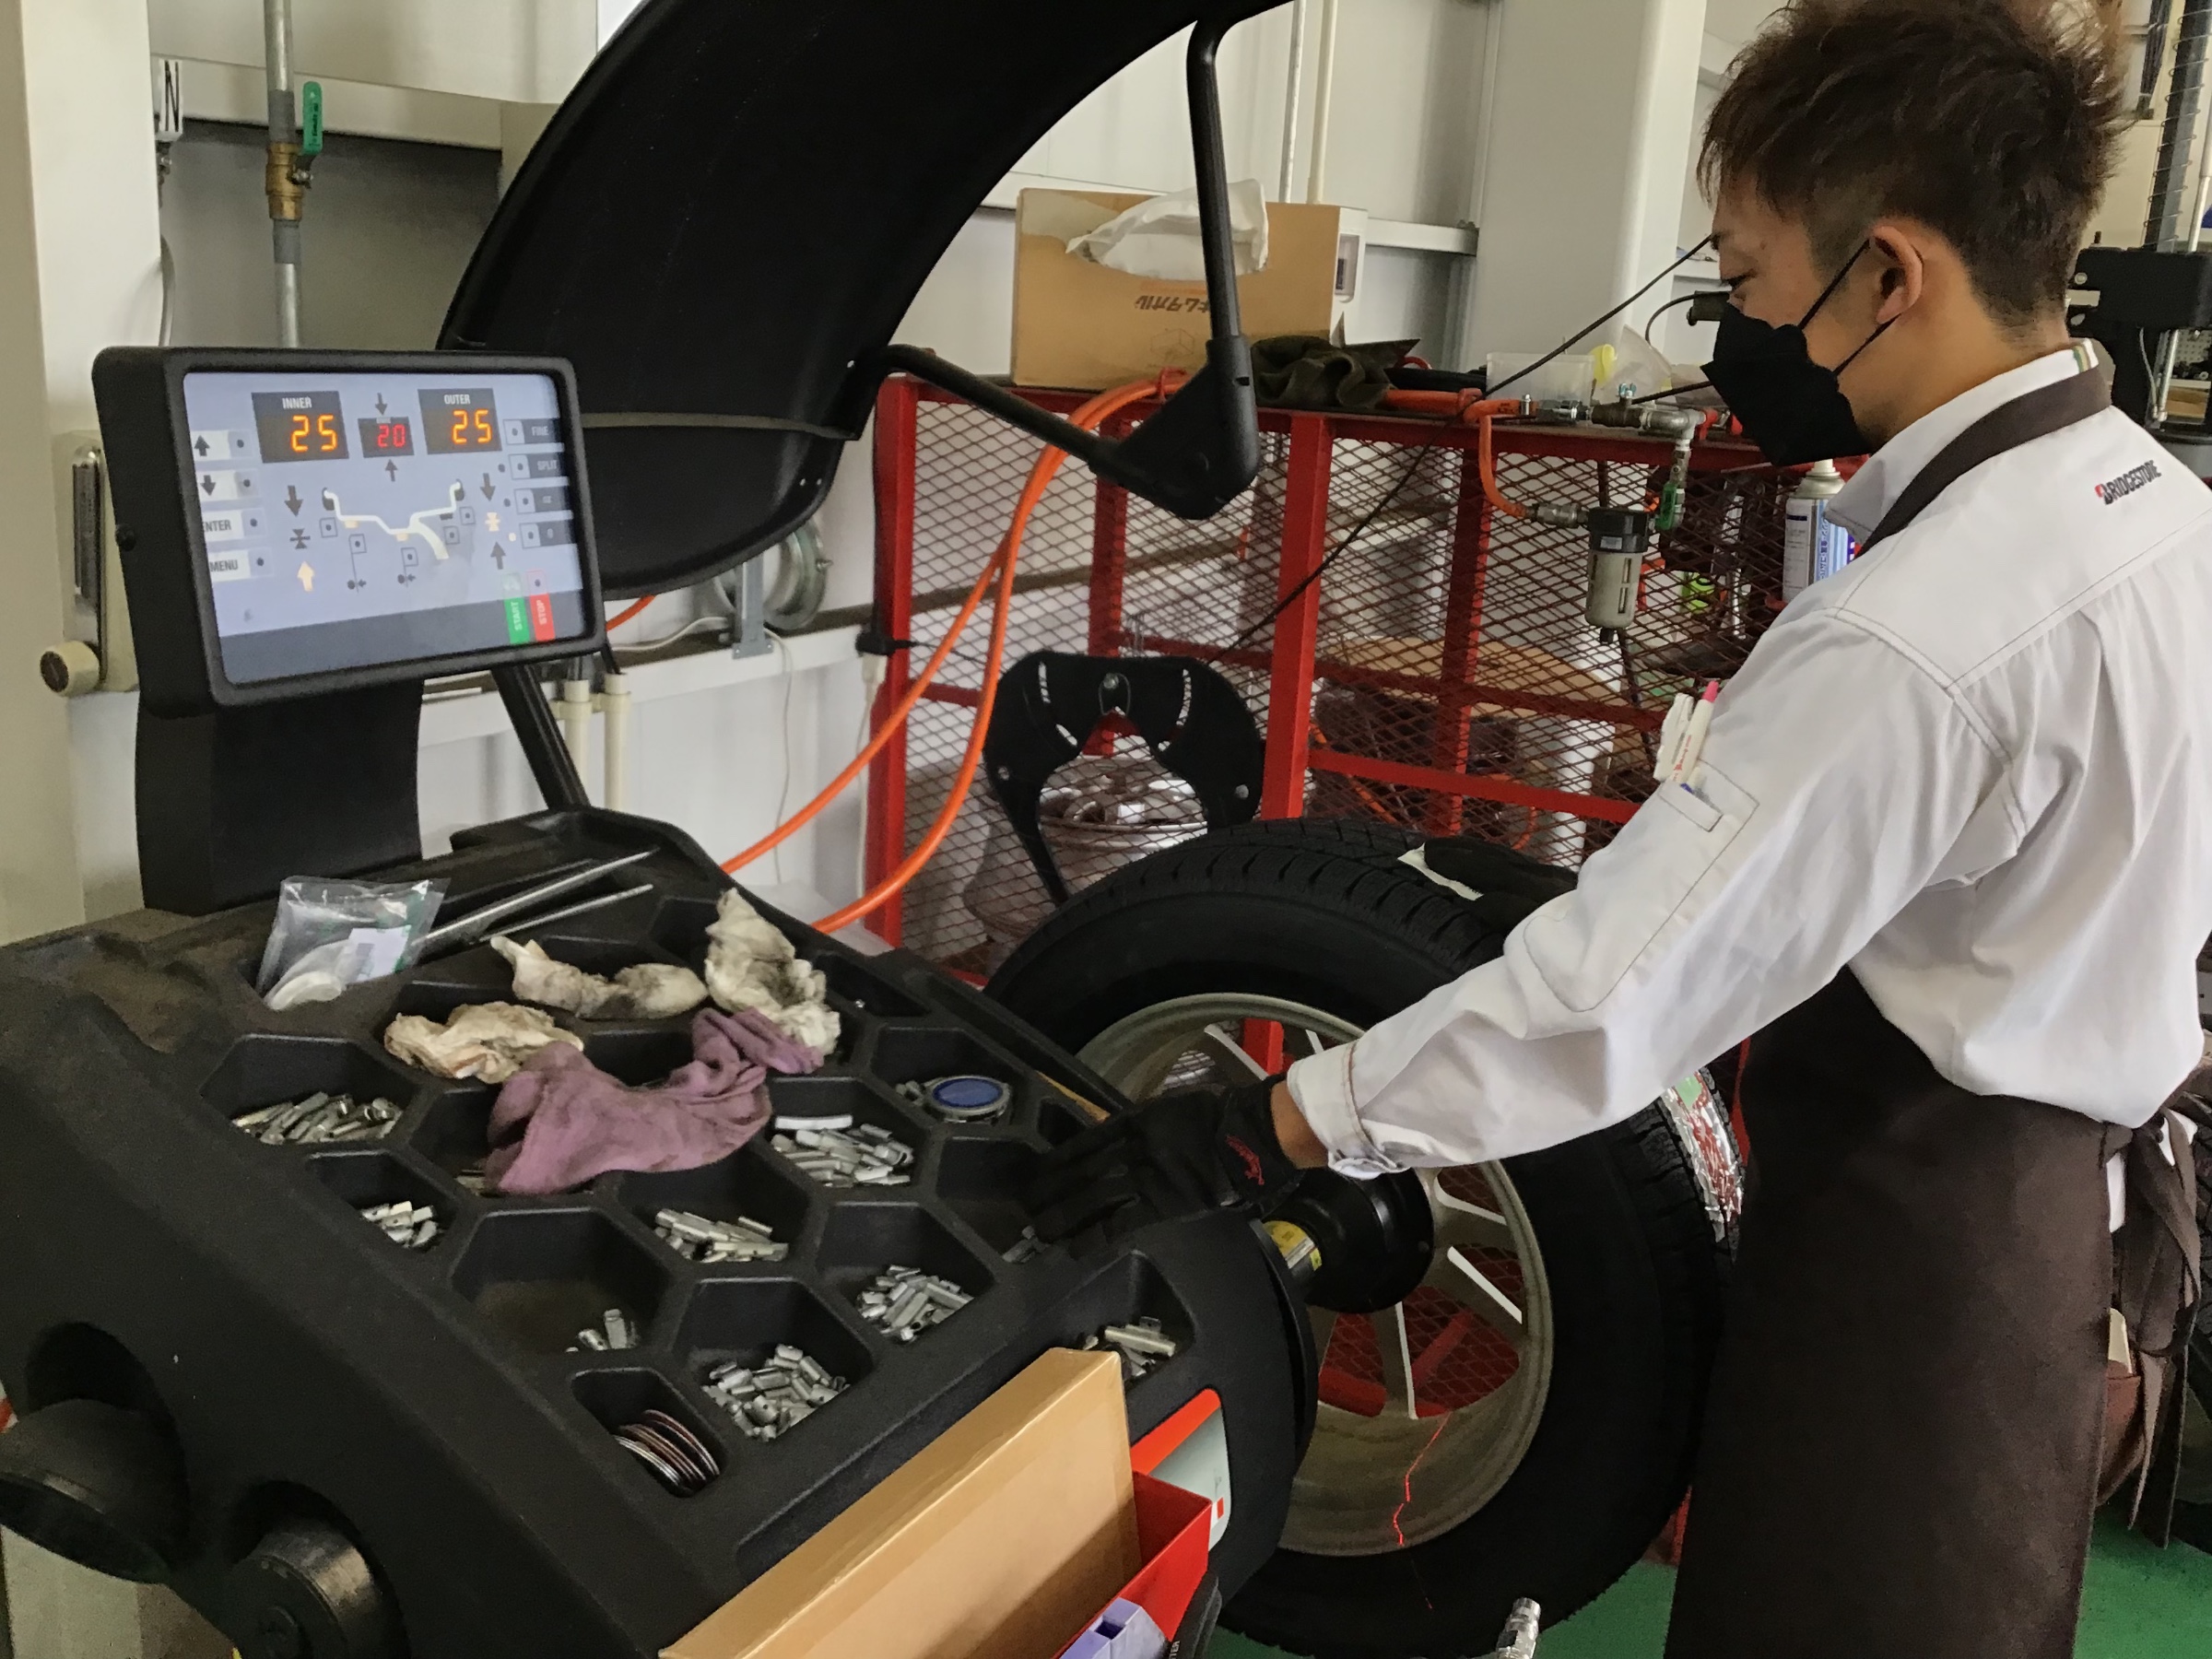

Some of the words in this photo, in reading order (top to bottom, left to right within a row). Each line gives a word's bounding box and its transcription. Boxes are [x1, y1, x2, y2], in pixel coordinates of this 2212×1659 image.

[282, 396, 312, 409] INNER
[443, 394, 471, 405] OUTER
[291, 415, 338, 453] 25
[377, 424, 406, 448] 20
[452, 409, 492, 444] 25
[2095, 460, 2162, 505] BRIDGESTONE
[209, 559, 239, 572] MENU
[511, 601, 523, 630] START
[536, 599, 548, 626] STOP
